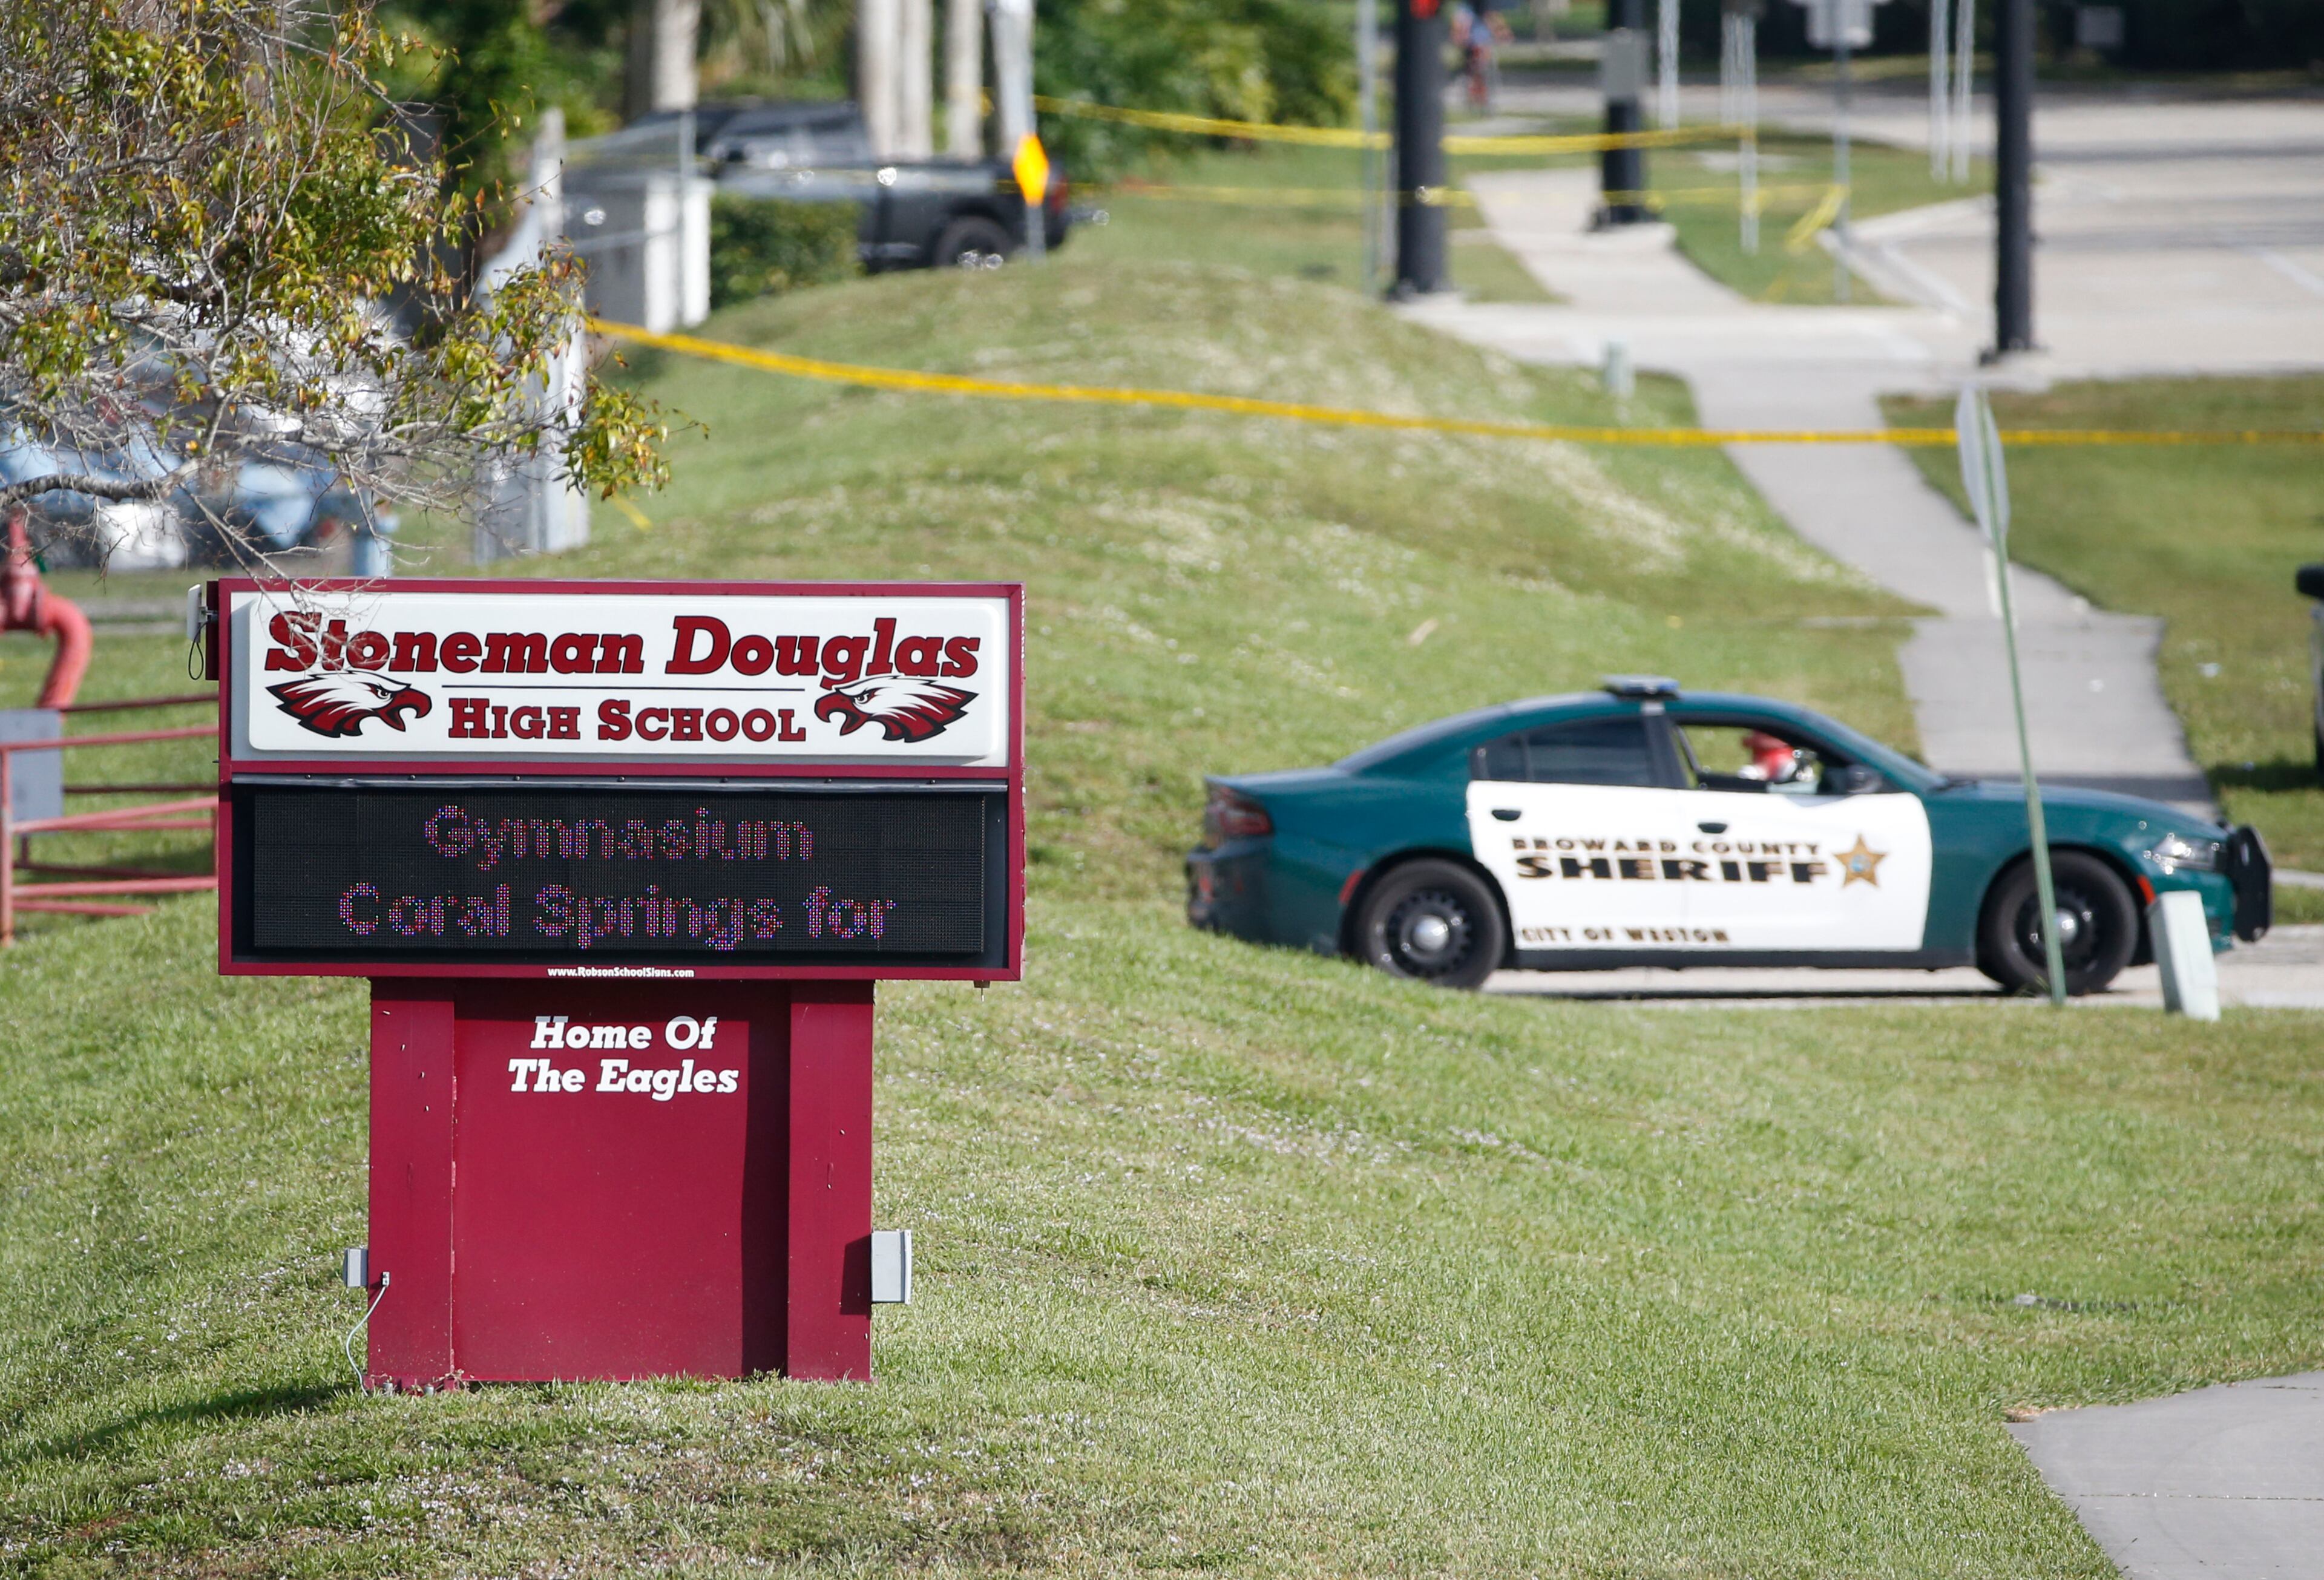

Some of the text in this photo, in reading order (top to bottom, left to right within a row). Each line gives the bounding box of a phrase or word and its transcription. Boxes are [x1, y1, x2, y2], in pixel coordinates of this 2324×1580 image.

[264, 610, 981, 690] Stoneman Douglas
[448, 698, 806, 742] HIGH SCHOOL
[424, 805, 813, 871] Gymnasium
[1512, 838, 1818, 854] BROWARD COUNTY
[1516, 856, 1827, 883] SHERIFF
[340, 882, 898, 951] Coral Springs for
[547, 966, 695, 978] www.RobsonSchoolSigns.com
[530, 1015, 718, 1050] Home Of
[508, 1058, 740, 1101] The Eagles
